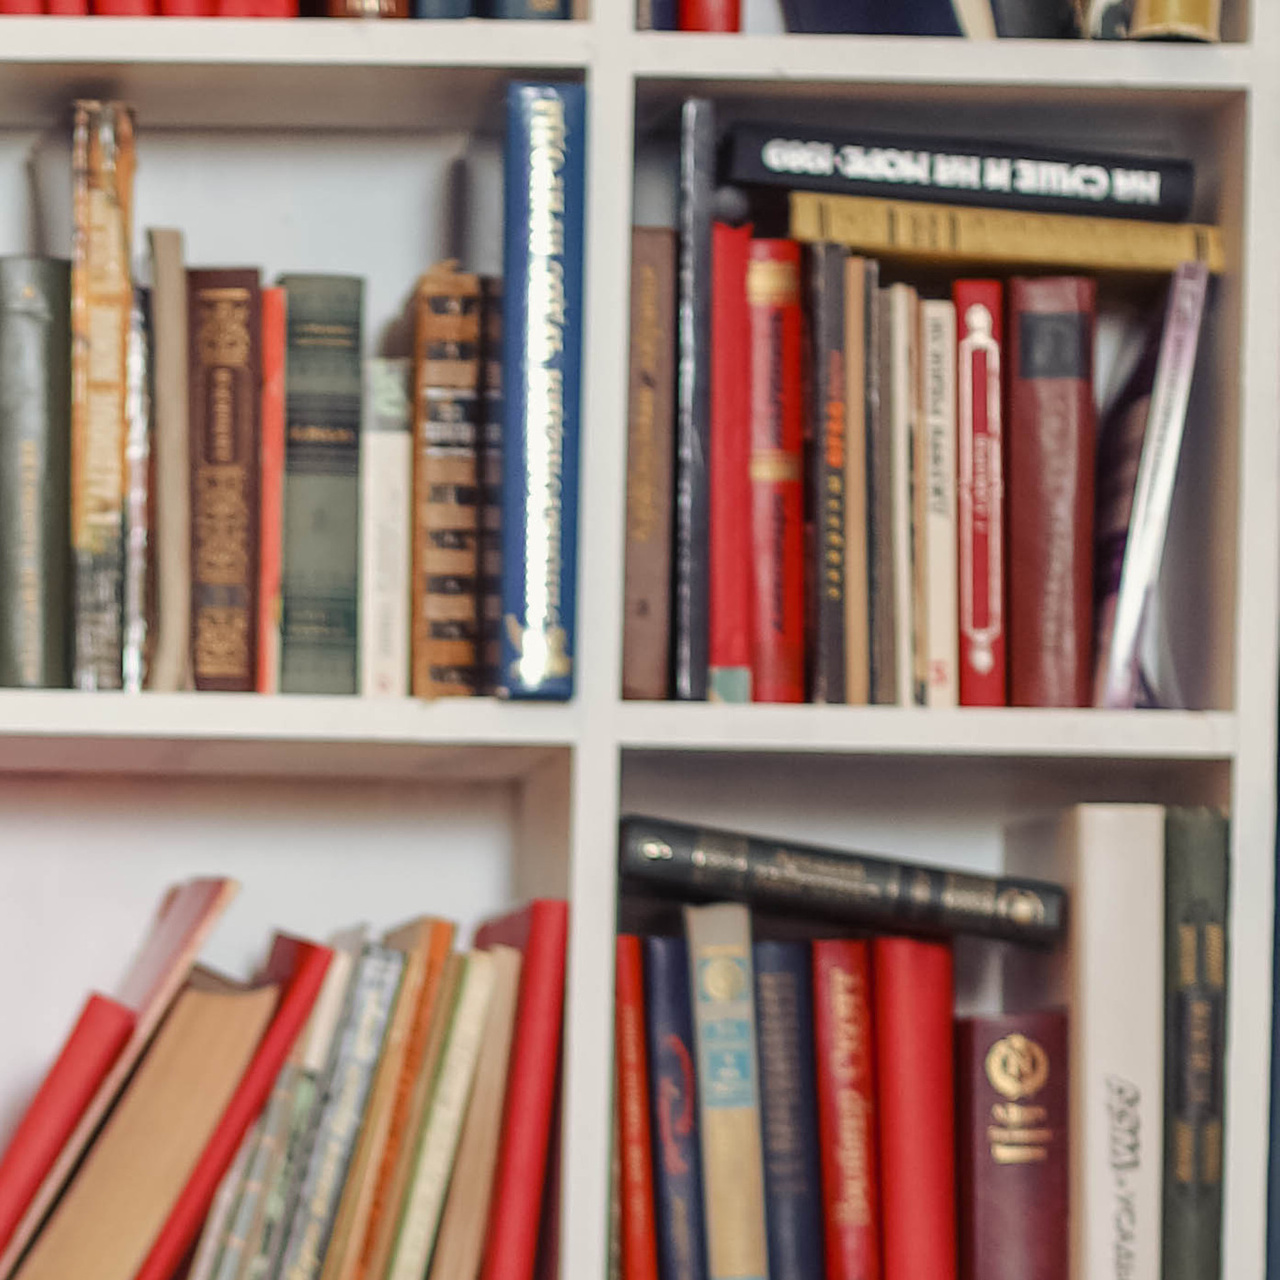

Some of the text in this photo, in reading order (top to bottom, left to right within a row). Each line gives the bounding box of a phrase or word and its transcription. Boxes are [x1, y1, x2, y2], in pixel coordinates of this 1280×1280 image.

[841, 145, 928, 184] МОРЕ
[930, 153, 981, 191] НА
[1017, 160, 1108, 201] СУШЕ
[1111, 167, 1160, 205] НА
